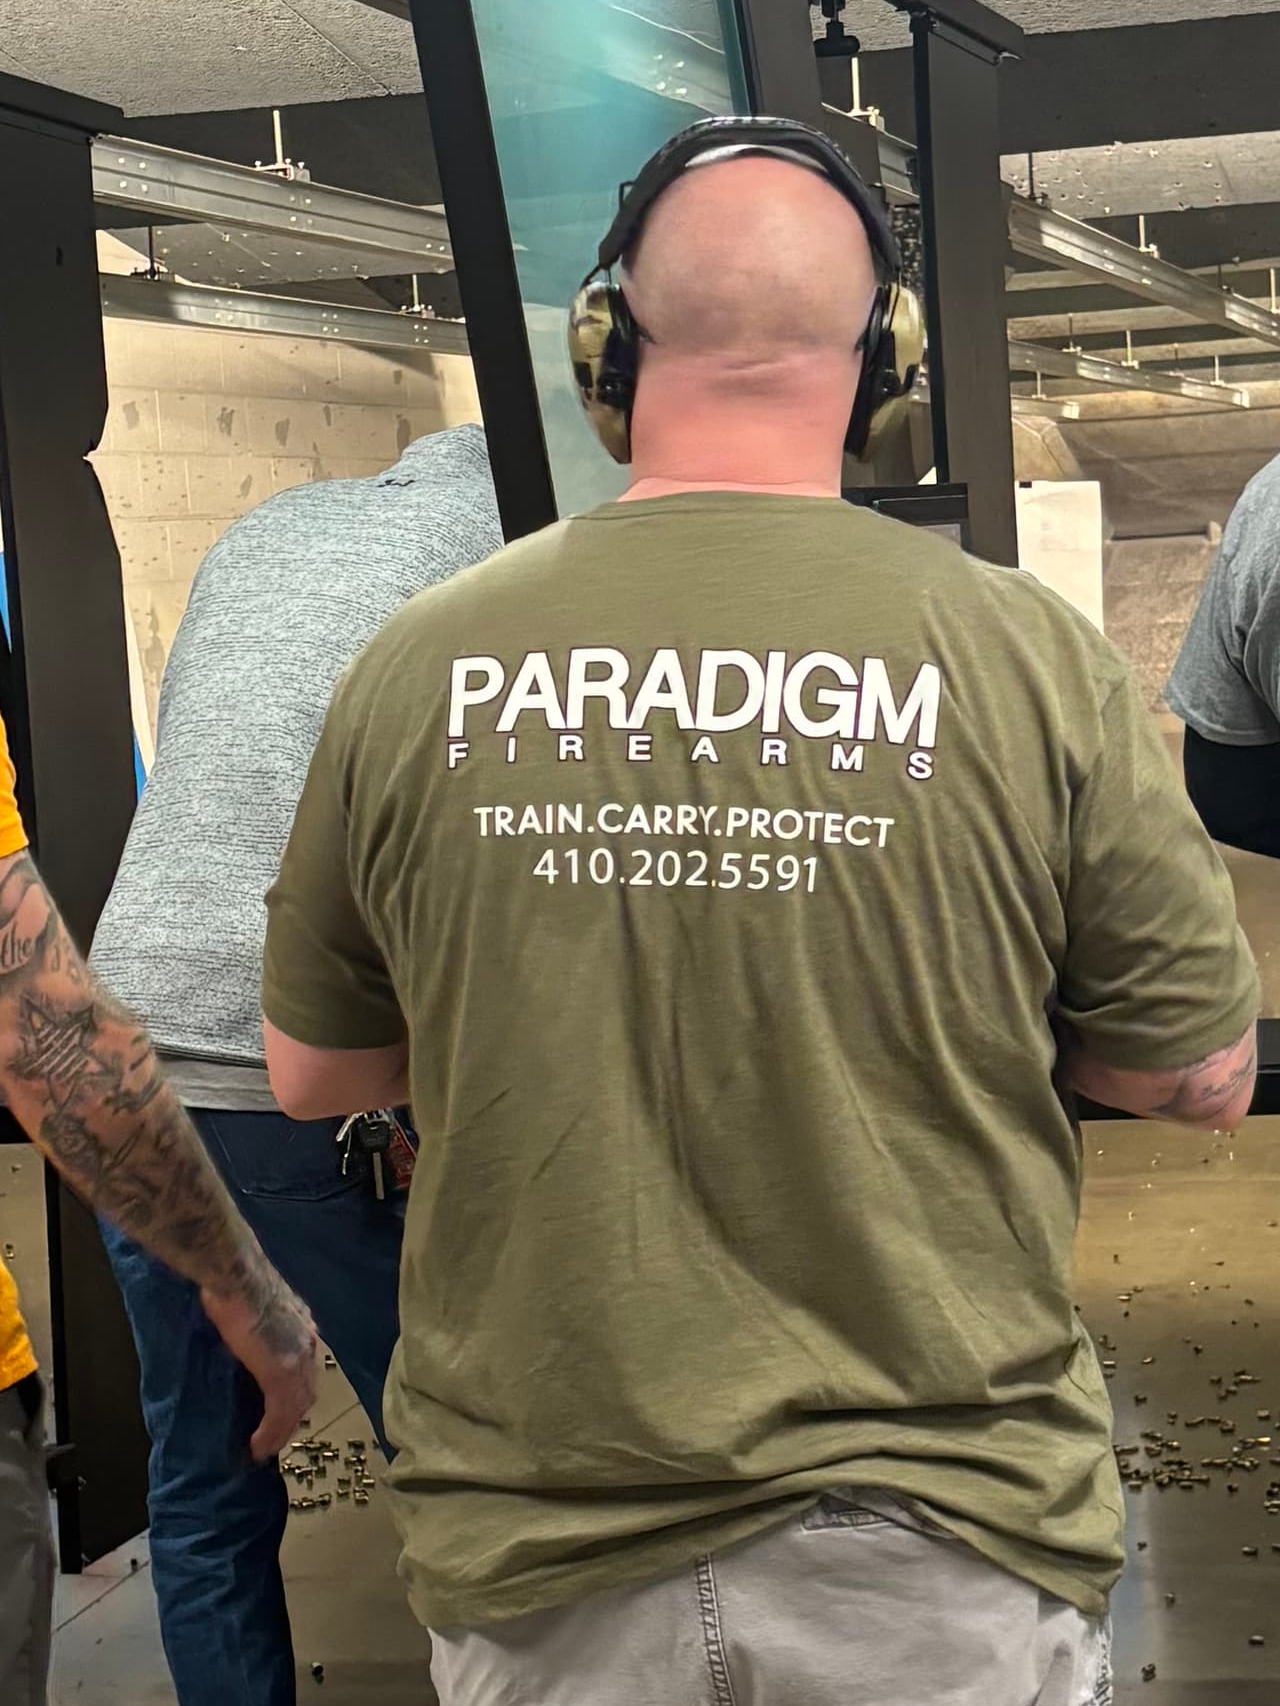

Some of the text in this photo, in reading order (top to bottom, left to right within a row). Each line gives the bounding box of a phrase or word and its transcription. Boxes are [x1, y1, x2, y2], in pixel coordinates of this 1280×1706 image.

[447, 646, 942, 749] PARADIGM
[447, 734, 936, 781] FIREARMS
[532, 848, 818, 893] 410.202.5591
